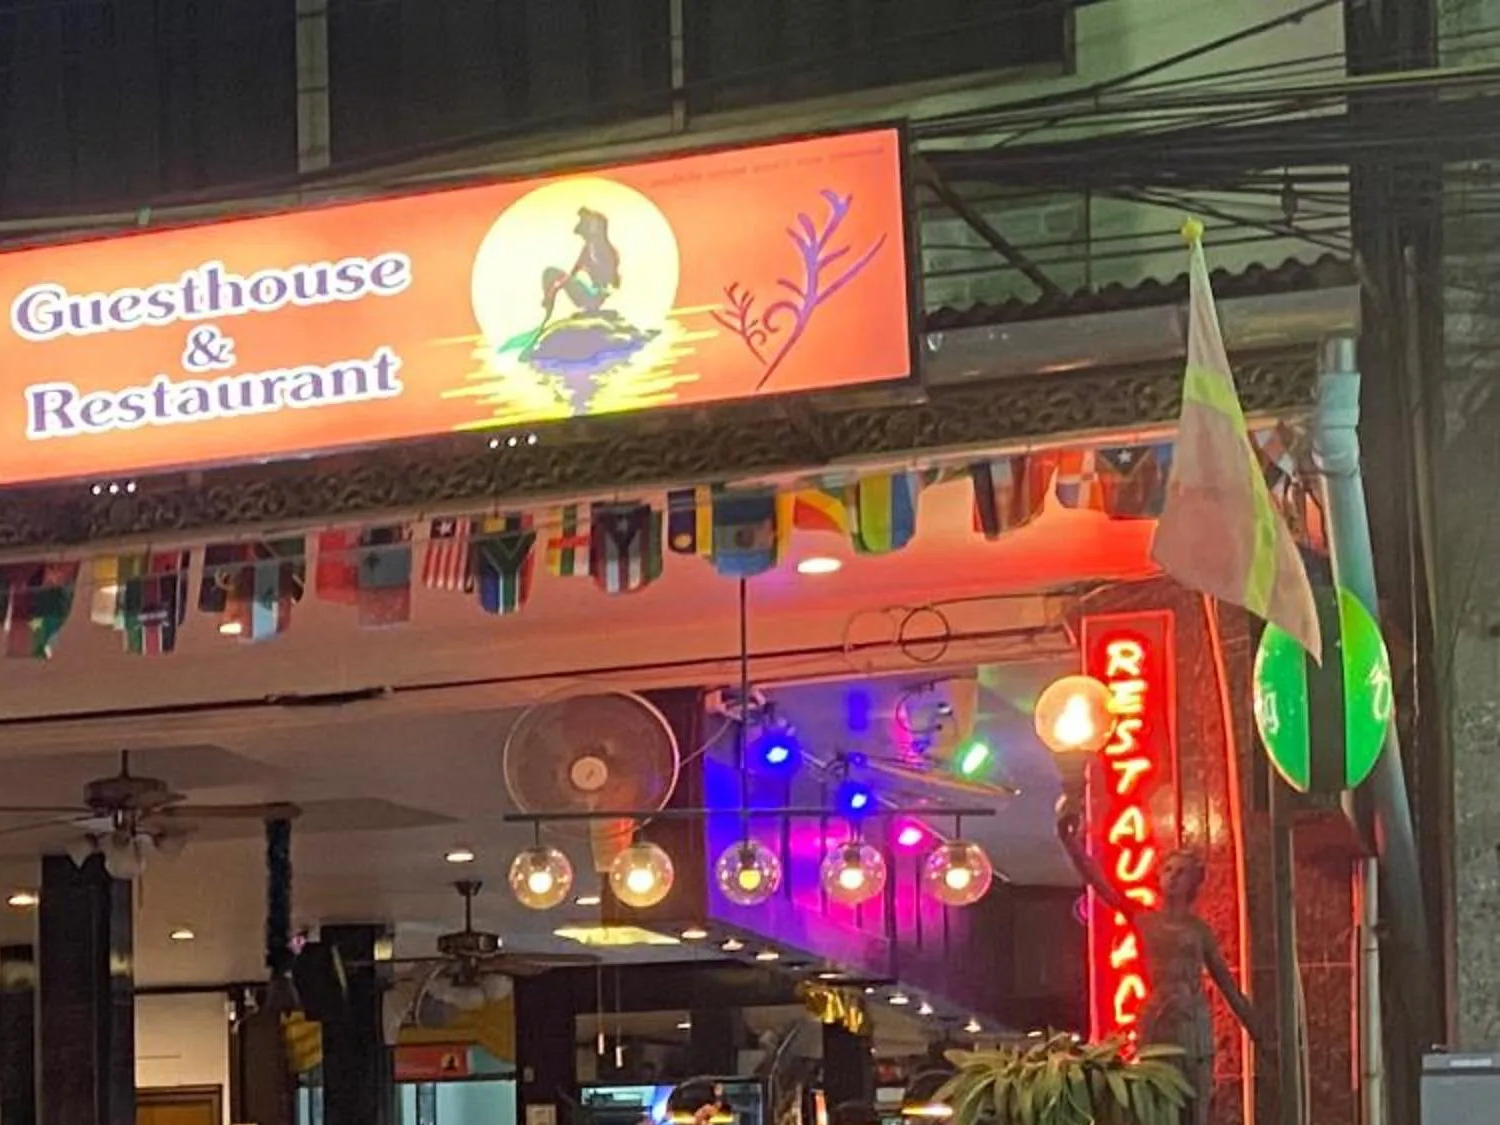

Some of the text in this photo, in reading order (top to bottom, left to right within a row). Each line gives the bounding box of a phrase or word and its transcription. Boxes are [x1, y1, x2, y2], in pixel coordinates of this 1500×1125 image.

[13, 255, 408, 338] Guesthouse
[185, 327, 232, 369] &
[30, 348, 401, 435] Restaurant
